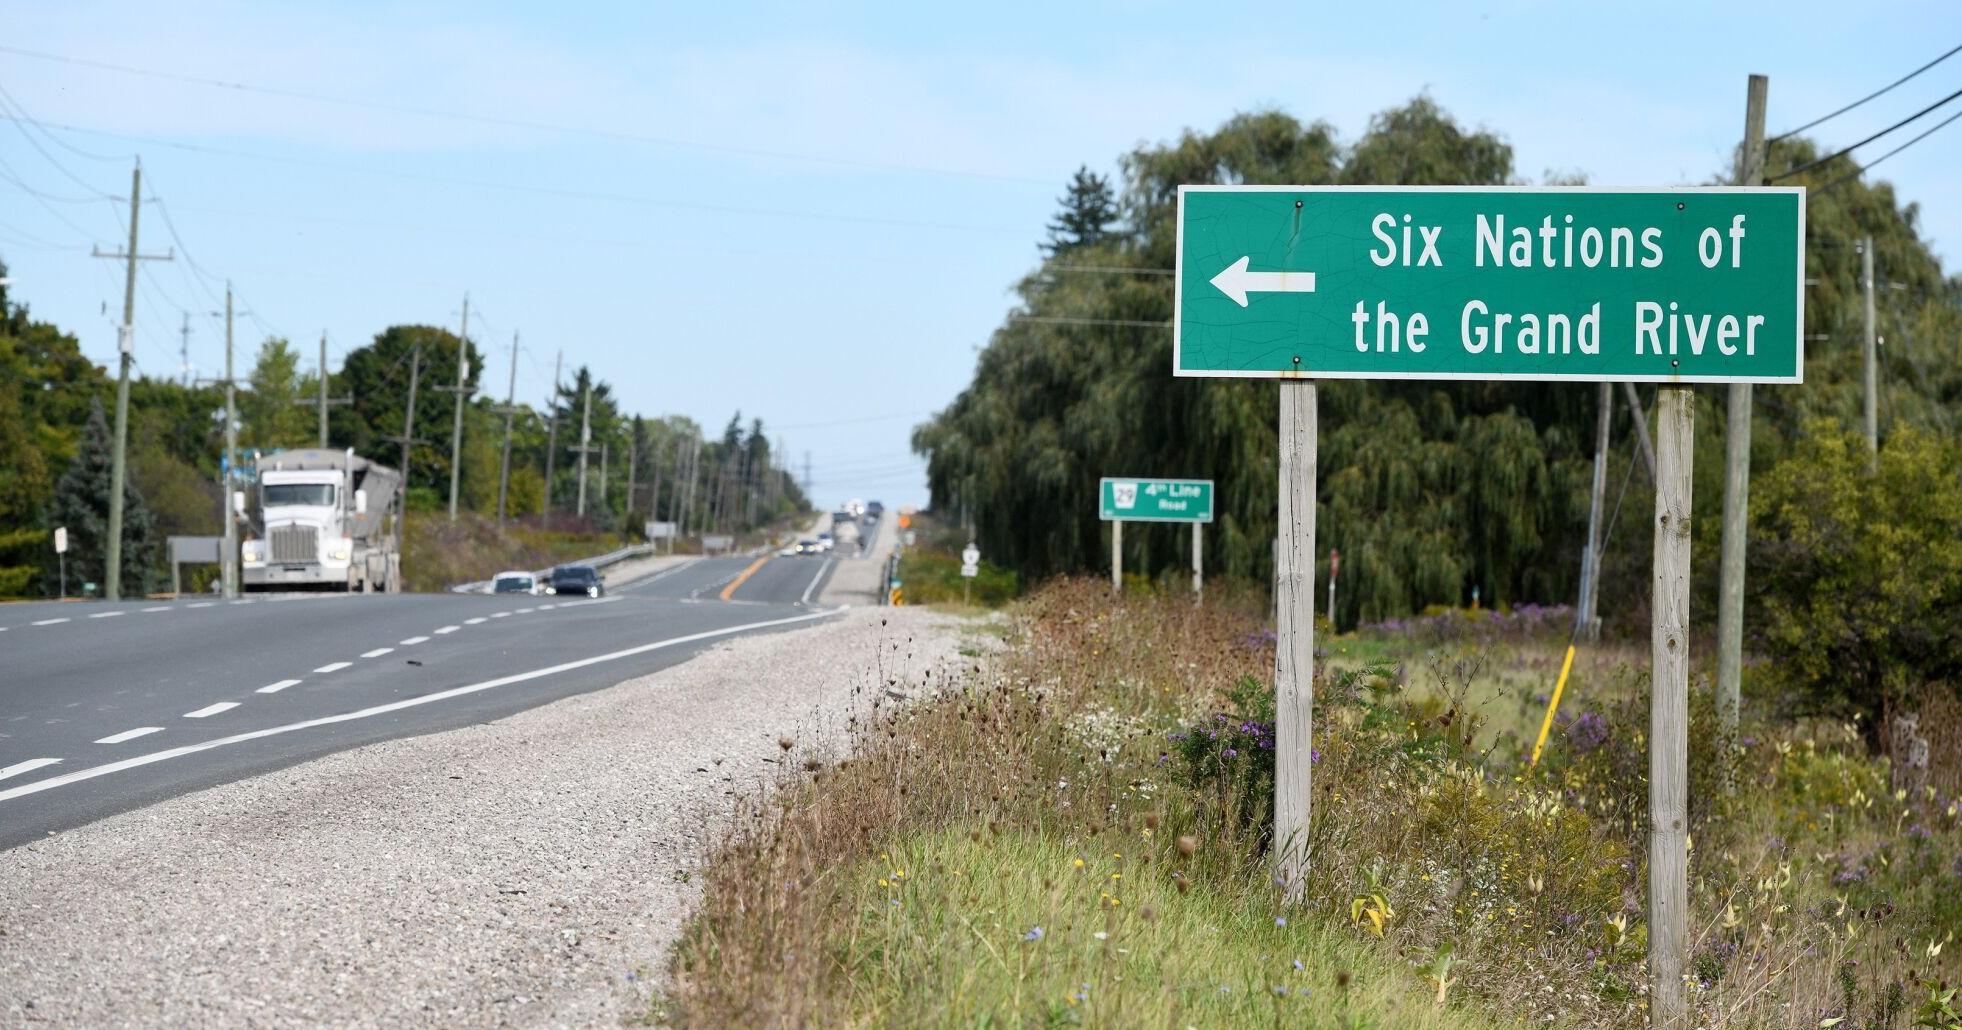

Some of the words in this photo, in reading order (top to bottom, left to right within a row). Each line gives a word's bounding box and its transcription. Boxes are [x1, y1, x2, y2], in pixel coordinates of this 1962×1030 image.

[1371, 214, 1442, 266] Six
[1476, 215, 1662, 267] Nations
[1699, 215, 1745, 267] of
[1352, 301, 1428, 352] the
[1462, 300, 1599, 354] Grand
[1636, 302, 1764, 355] River
[1159, 499, 1187, 511] Road
[1169, 484, 1201, 497] Line
